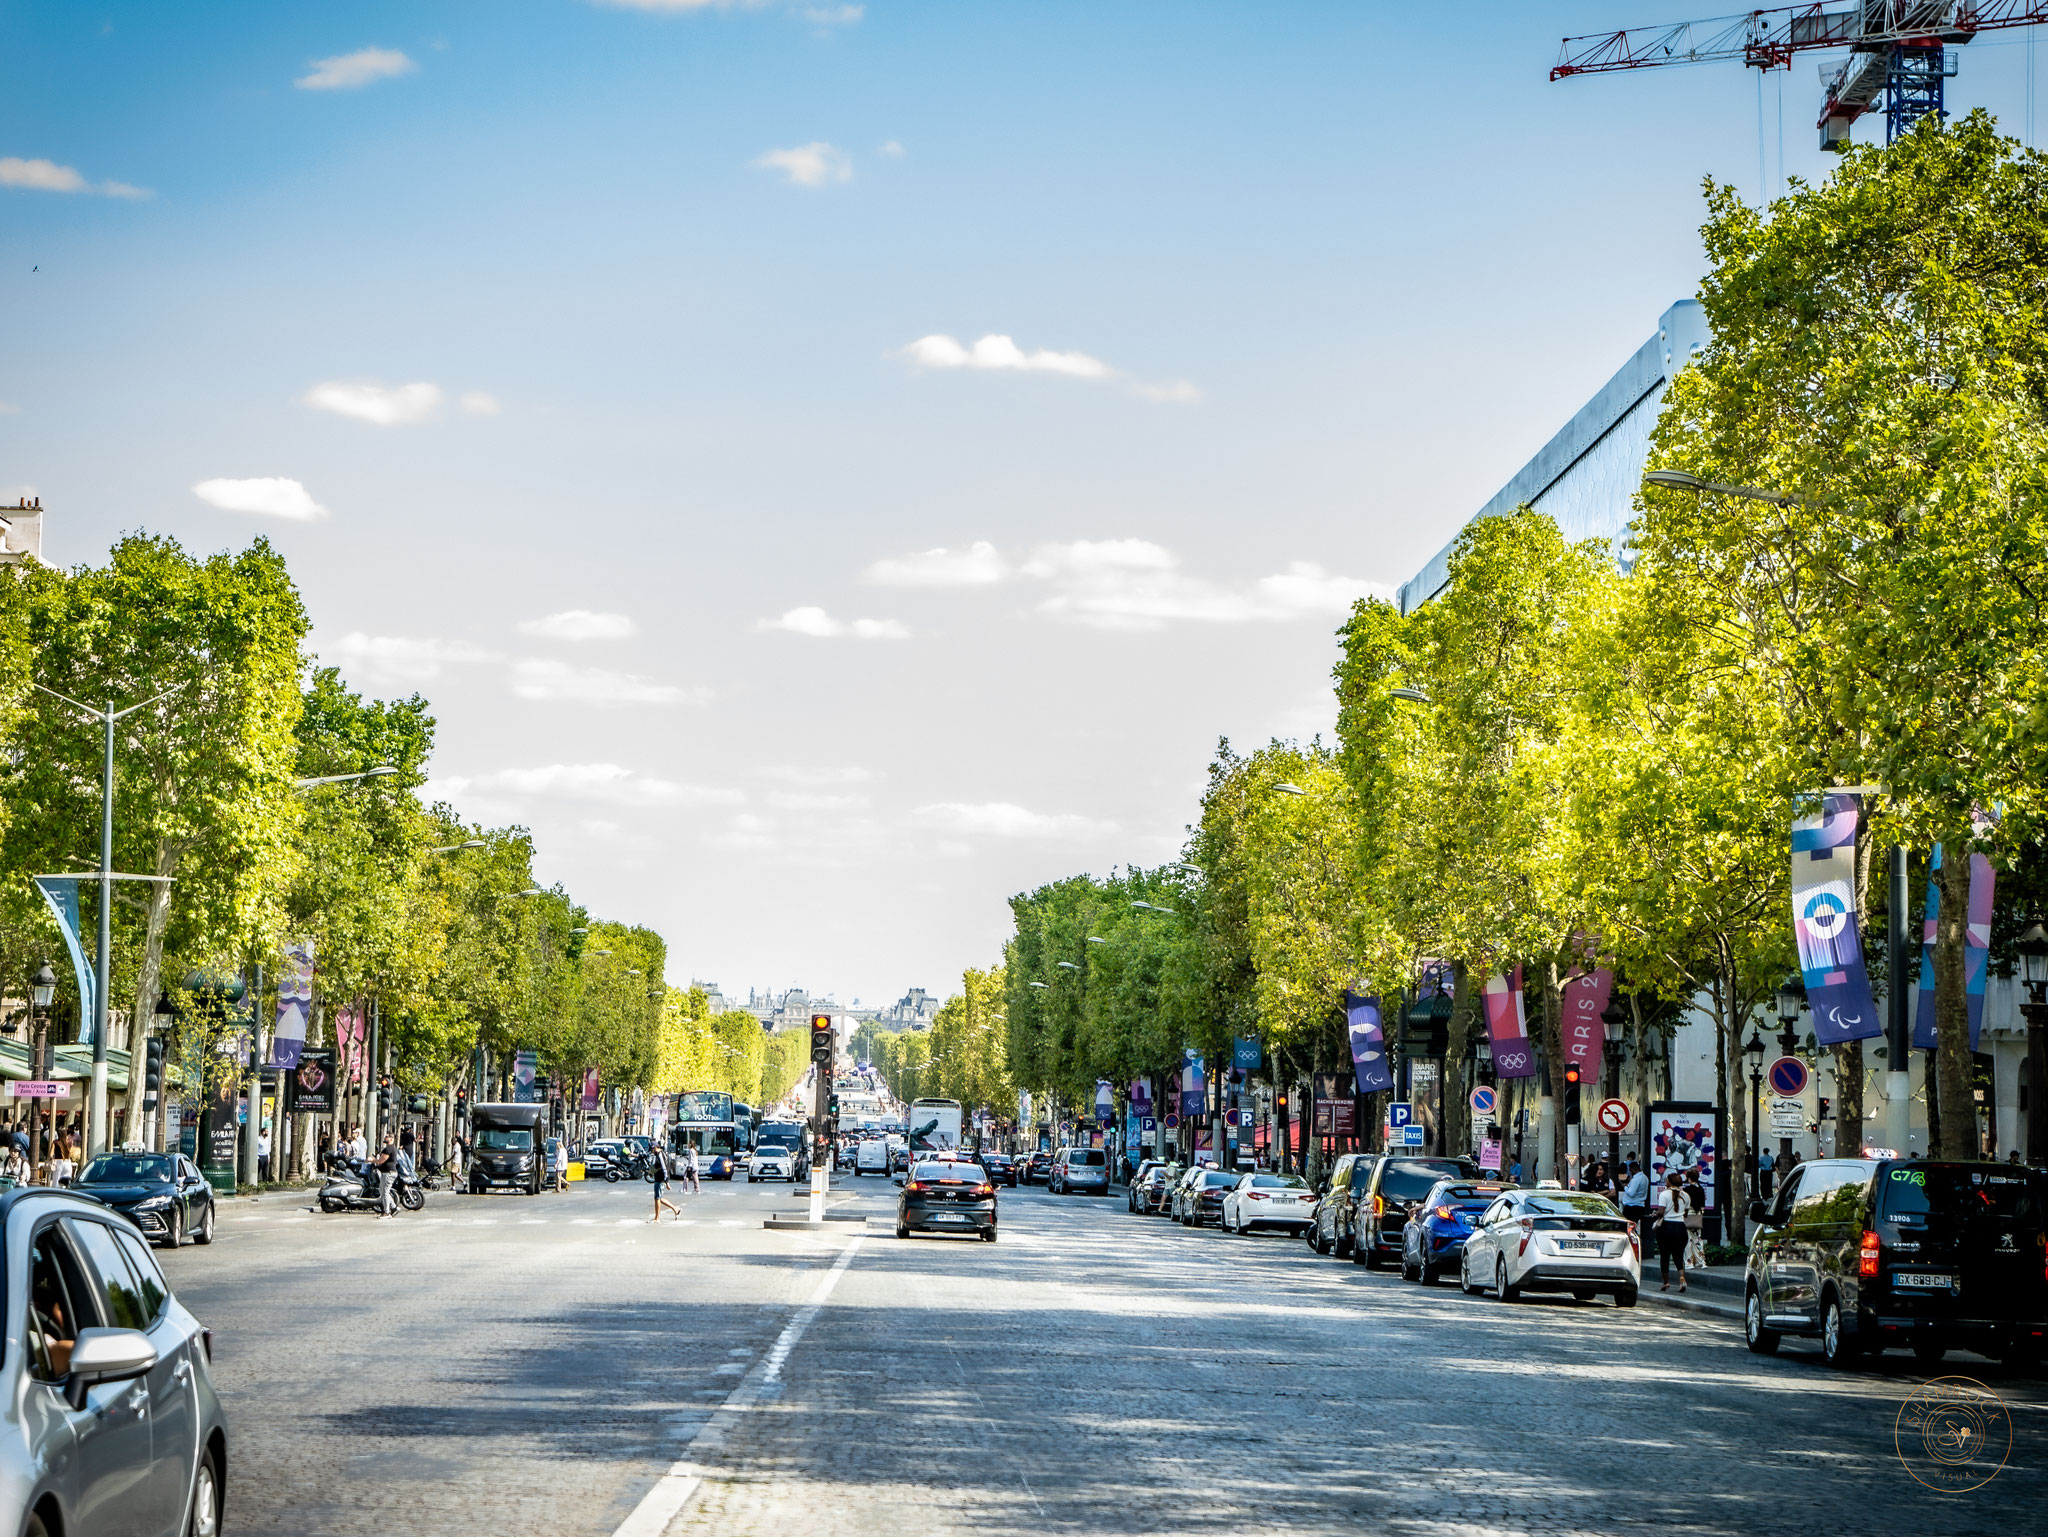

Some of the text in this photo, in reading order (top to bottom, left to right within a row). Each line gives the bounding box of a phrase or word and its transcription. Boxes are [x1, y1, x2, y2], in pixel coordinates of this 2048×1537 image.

[1241, 1112, 1253, 1127] P
[1396, 1107, 1408, 1124] P
[1145, 1119, 1152, 1129] P
[1890, 1169, 1911, 1181] G7
[1889, 1214, 1911, 1222] 13906
